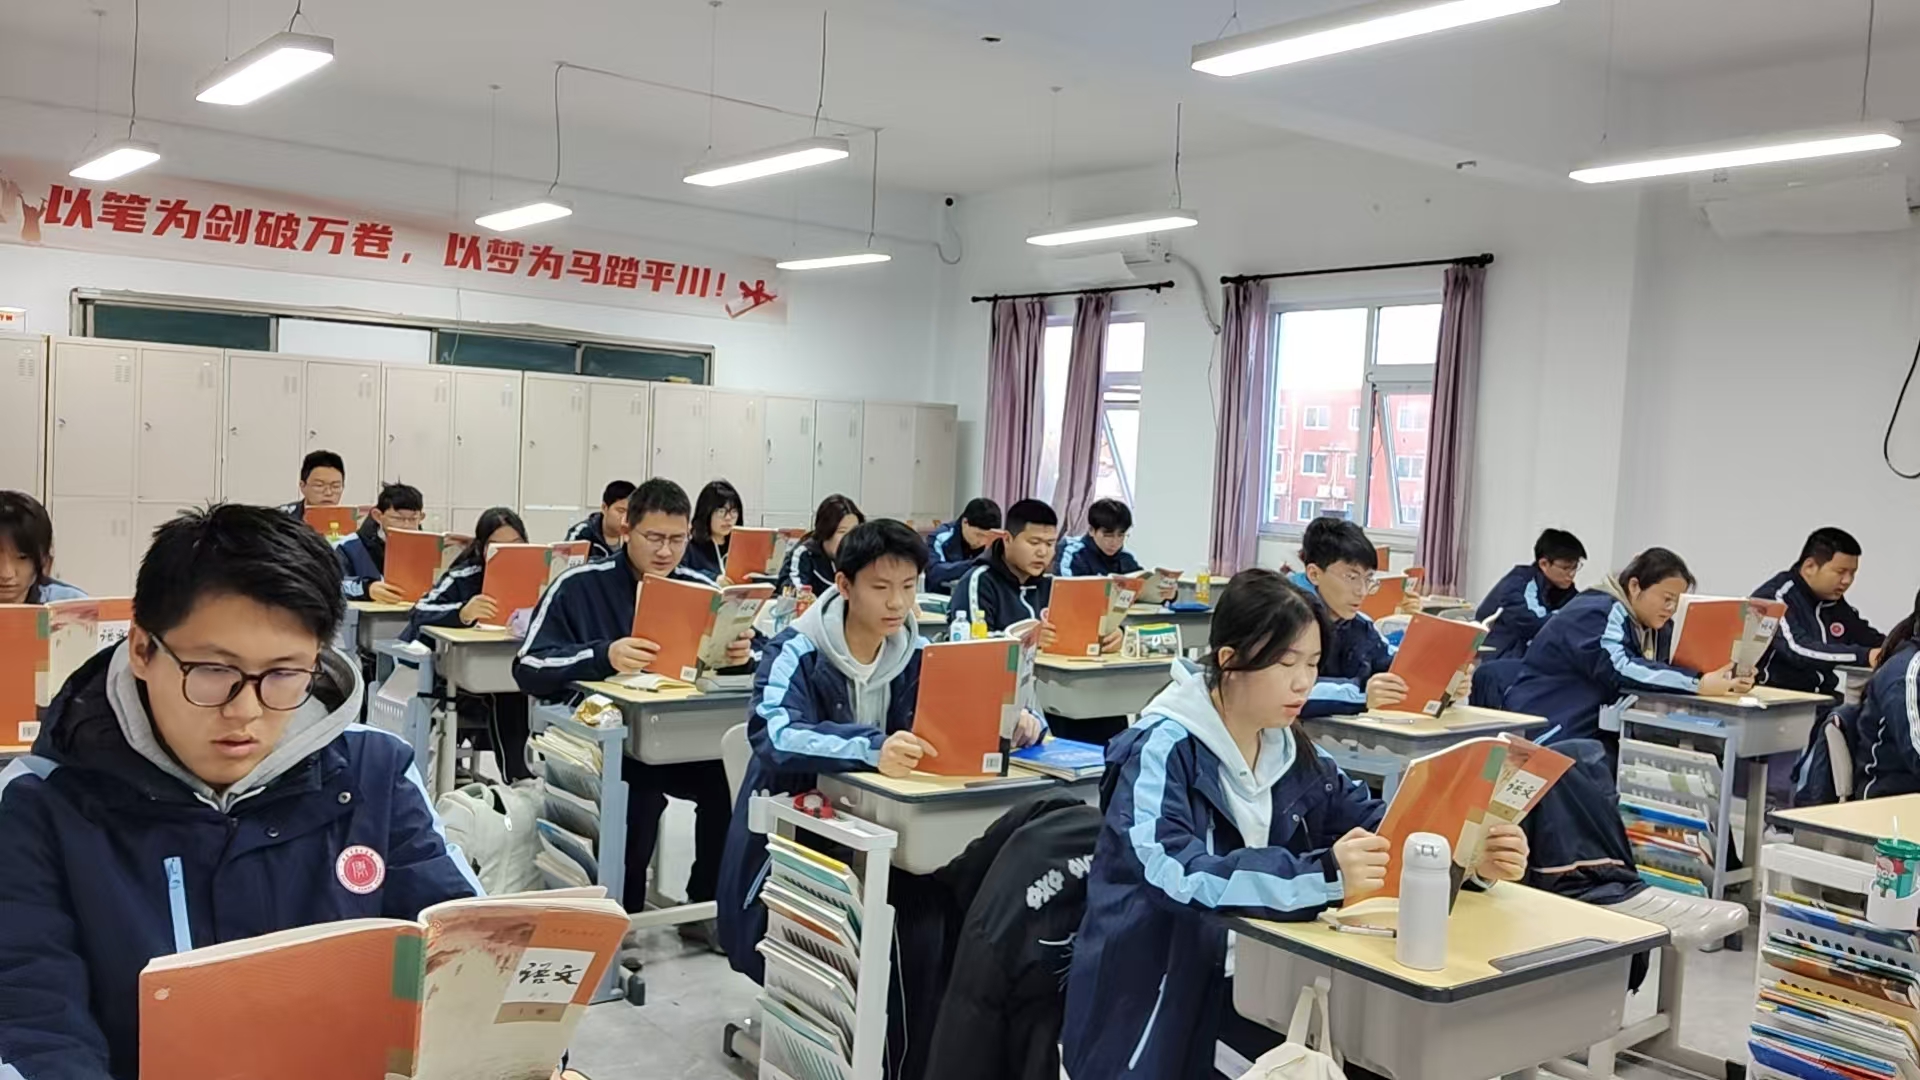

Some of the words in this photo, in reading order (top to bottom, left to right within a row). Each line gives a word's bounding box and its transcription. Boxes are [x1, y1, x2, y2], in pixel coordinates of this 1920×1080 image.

[44, 183, 413, 264] 以笔为剑破万卷，
[443, 231, 727, 299] 以梦为马踏平川！
[1505, 778, 1537, 800] 语文
[518, 961, 584, 986] 语文
